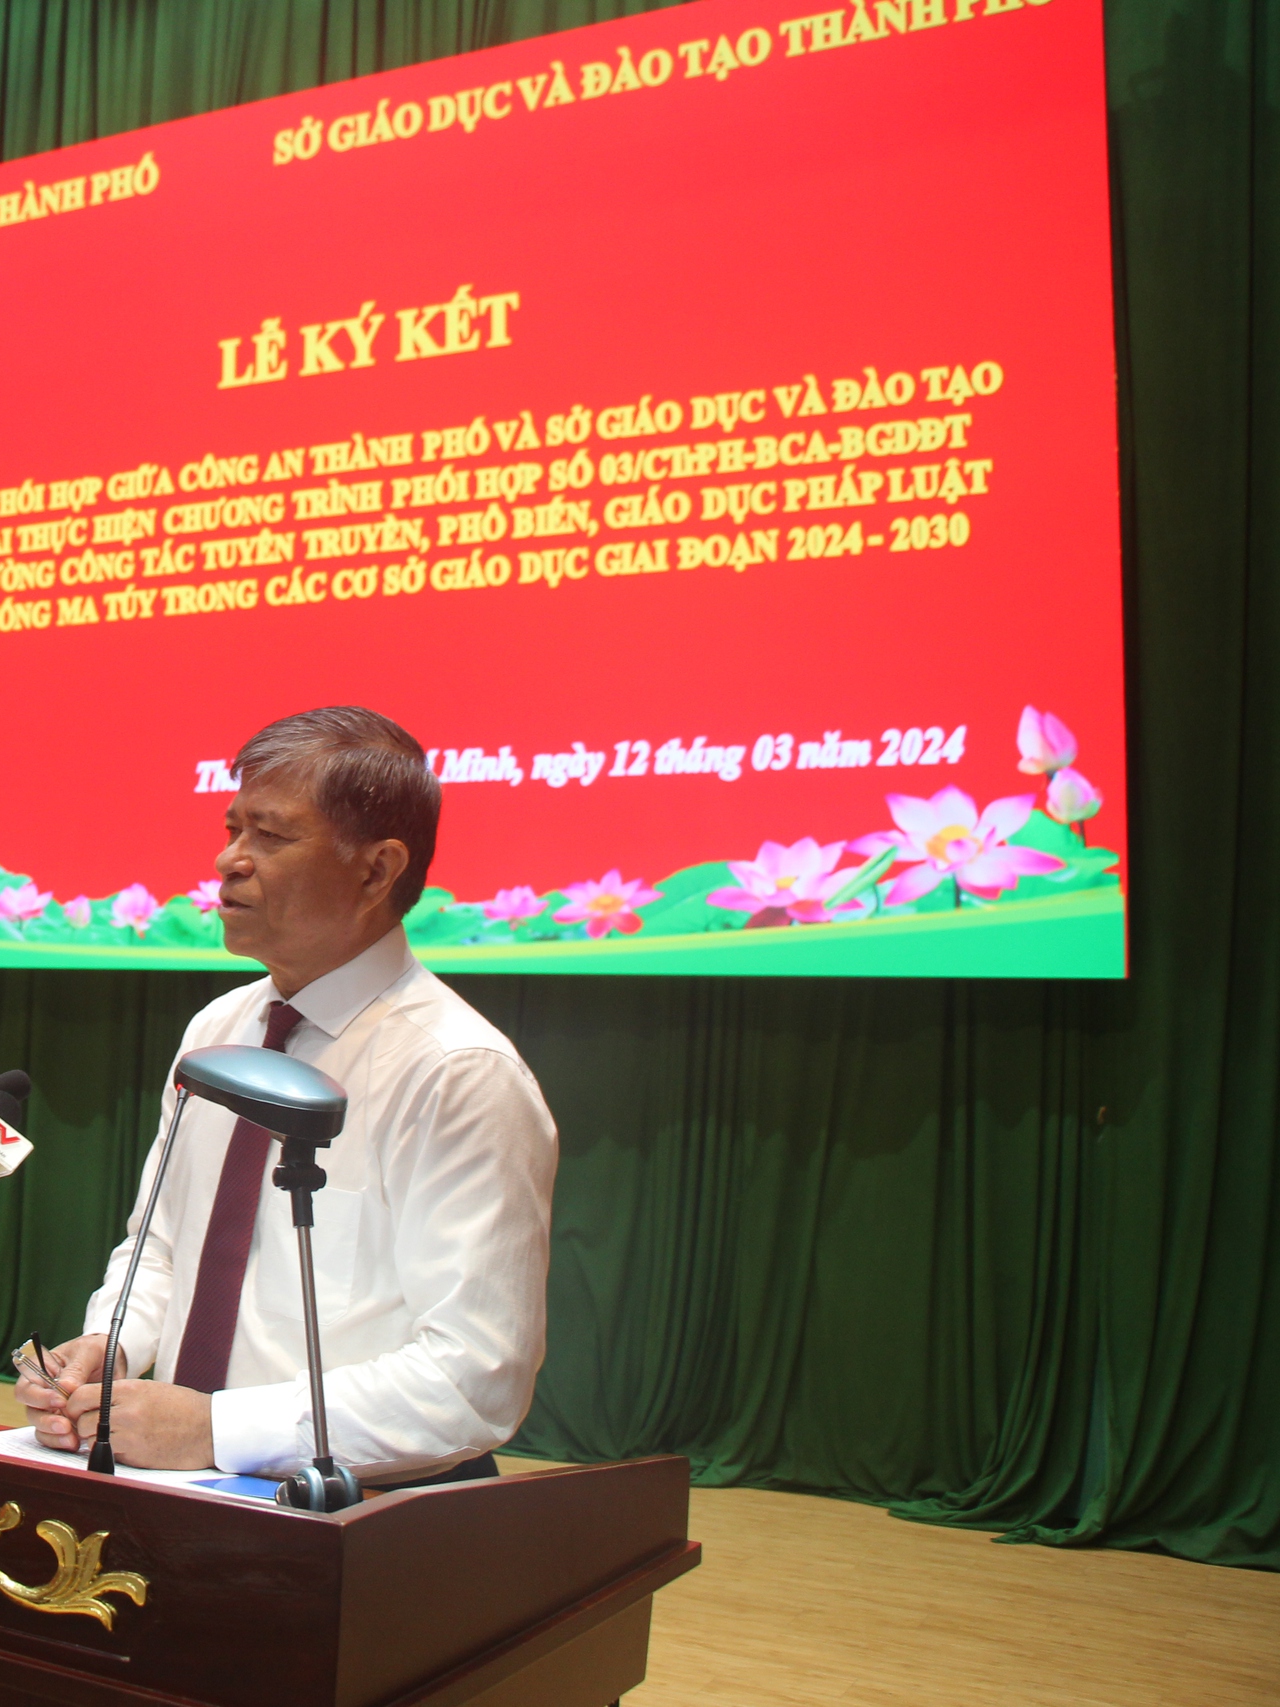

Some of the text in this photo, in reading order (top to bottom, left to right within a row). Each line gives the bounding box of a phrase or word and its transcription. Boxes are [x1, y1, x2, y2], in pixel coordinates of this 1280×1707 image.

[273, 116, 323, 165] SỞ
[327, 99, 423, 151] GIÁO
[427, 82, 513, 133] DỤC
[517, 61, 575, 110] VÀ
[580, 47, 673, 99] ĐÀO
[679, 27, 772, 81] TẠO
[779, 0, 948, 57] THÀNH
[89, 152, 159, 205] PHỐ
[217, 284, 519, 389] LỄ KÝ KẾT
[48, 475, 103, 513] HỢP
[106, 463, 175, 502] GIỮA
[178, 452, 259, 493] CÔNG
[262, 447, 305, 482] AN
[309, 432, 414, 476] THÀNH
[421, 416, 491, 462] PHỐ
[493, 410, 541, 452] VÀ
[545, 404, 593, 447] SỞ
[596, 394, 684, 440] GIÁO
[690, 389, 766, 433] DỤC
[772, 374, 828, 418] VÀ
[831, 366, 916, 413] ĐÀO
[921, 361, 1004, 406] TẠO
[17, 516, 88, 555] THỰC
[92, 507, 157, 546] HIỆN
[162, 493, 285, 535] CHƯƠNG
[291, 478, 383, 521] TRÌNH
[390, 464, 469, 509] PHỐI
[474, 462, 543, 503] HỢP
[548, 448, 594, 492] SỐ
[60, 548, 135, 585] CÔNG
[140, 539, 195, 577] TÁC
[201, 527, 295, 571] TUYÊN
[303, 514, 430, 560] TRUYỀN,
[511, 495, 599, 539] BIẾN,
[604, 484, 691, 529] GIÁO
[700, 481, 777, 525] DỤC
[782, 463, 884, 512] PHÁP
[887, 457, 993, 504] LUẬT
[56, 596, 99, 626] MA
[103, 583, 157, 622] TÚY
[161, 579, 258, 615] TRONG
[265, 566, 327, 606] CÁC
[331, 565, 379, 600] CƠ
[382, 555, 427, 596] SỞ
[430, 549, 511, 591] GIÁO
[518, 546, 589, 588] DỤC
[595, 538, 669, 576] GIAI
[677, 529, 780, 573] ĐOẠN
[786, 521, 863, 561] 2024
[889, 512, 970, 552] 2030
[438, 744, 524, 787] Minh,
[531, 742, 605, 787] ngày
[608, 739, 651, 777] 12
[654, 735, 747, 782] tháng
[751, 732, 794, 771] 03
[796, 730, 872, 770] năm
[876, 724, 968, 767] 2024
